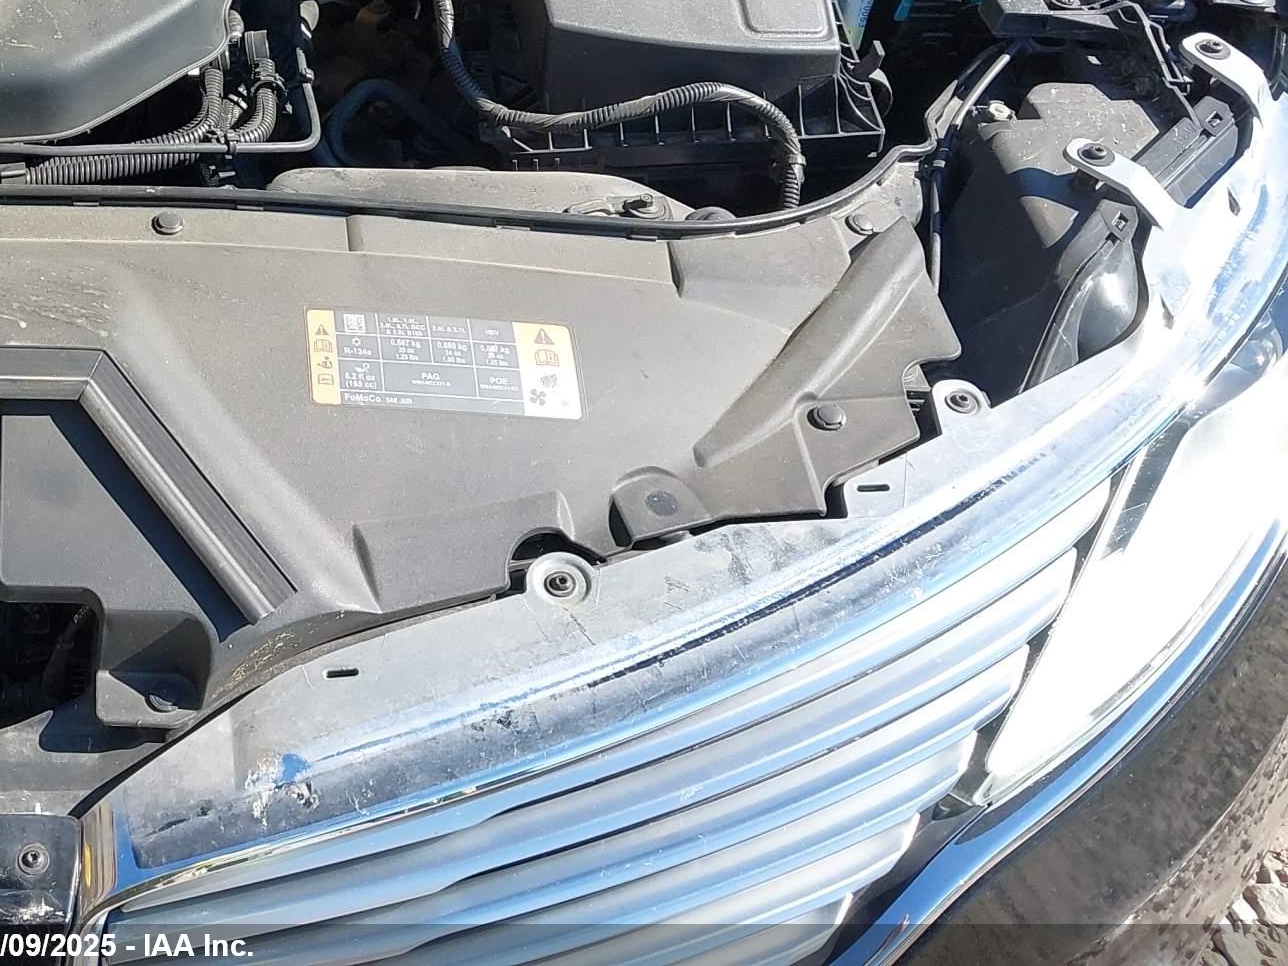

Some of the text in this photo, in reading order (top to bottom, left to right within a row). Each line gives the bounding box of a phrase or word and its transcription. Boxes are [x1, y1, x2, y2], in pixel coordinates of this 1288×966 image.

[343, 347, 372, 356] R-134a
[421, 371, 441, 381] PAG
[489, 376, 511, 385] POE
[344, 393, 382, 403] FoMoCo
